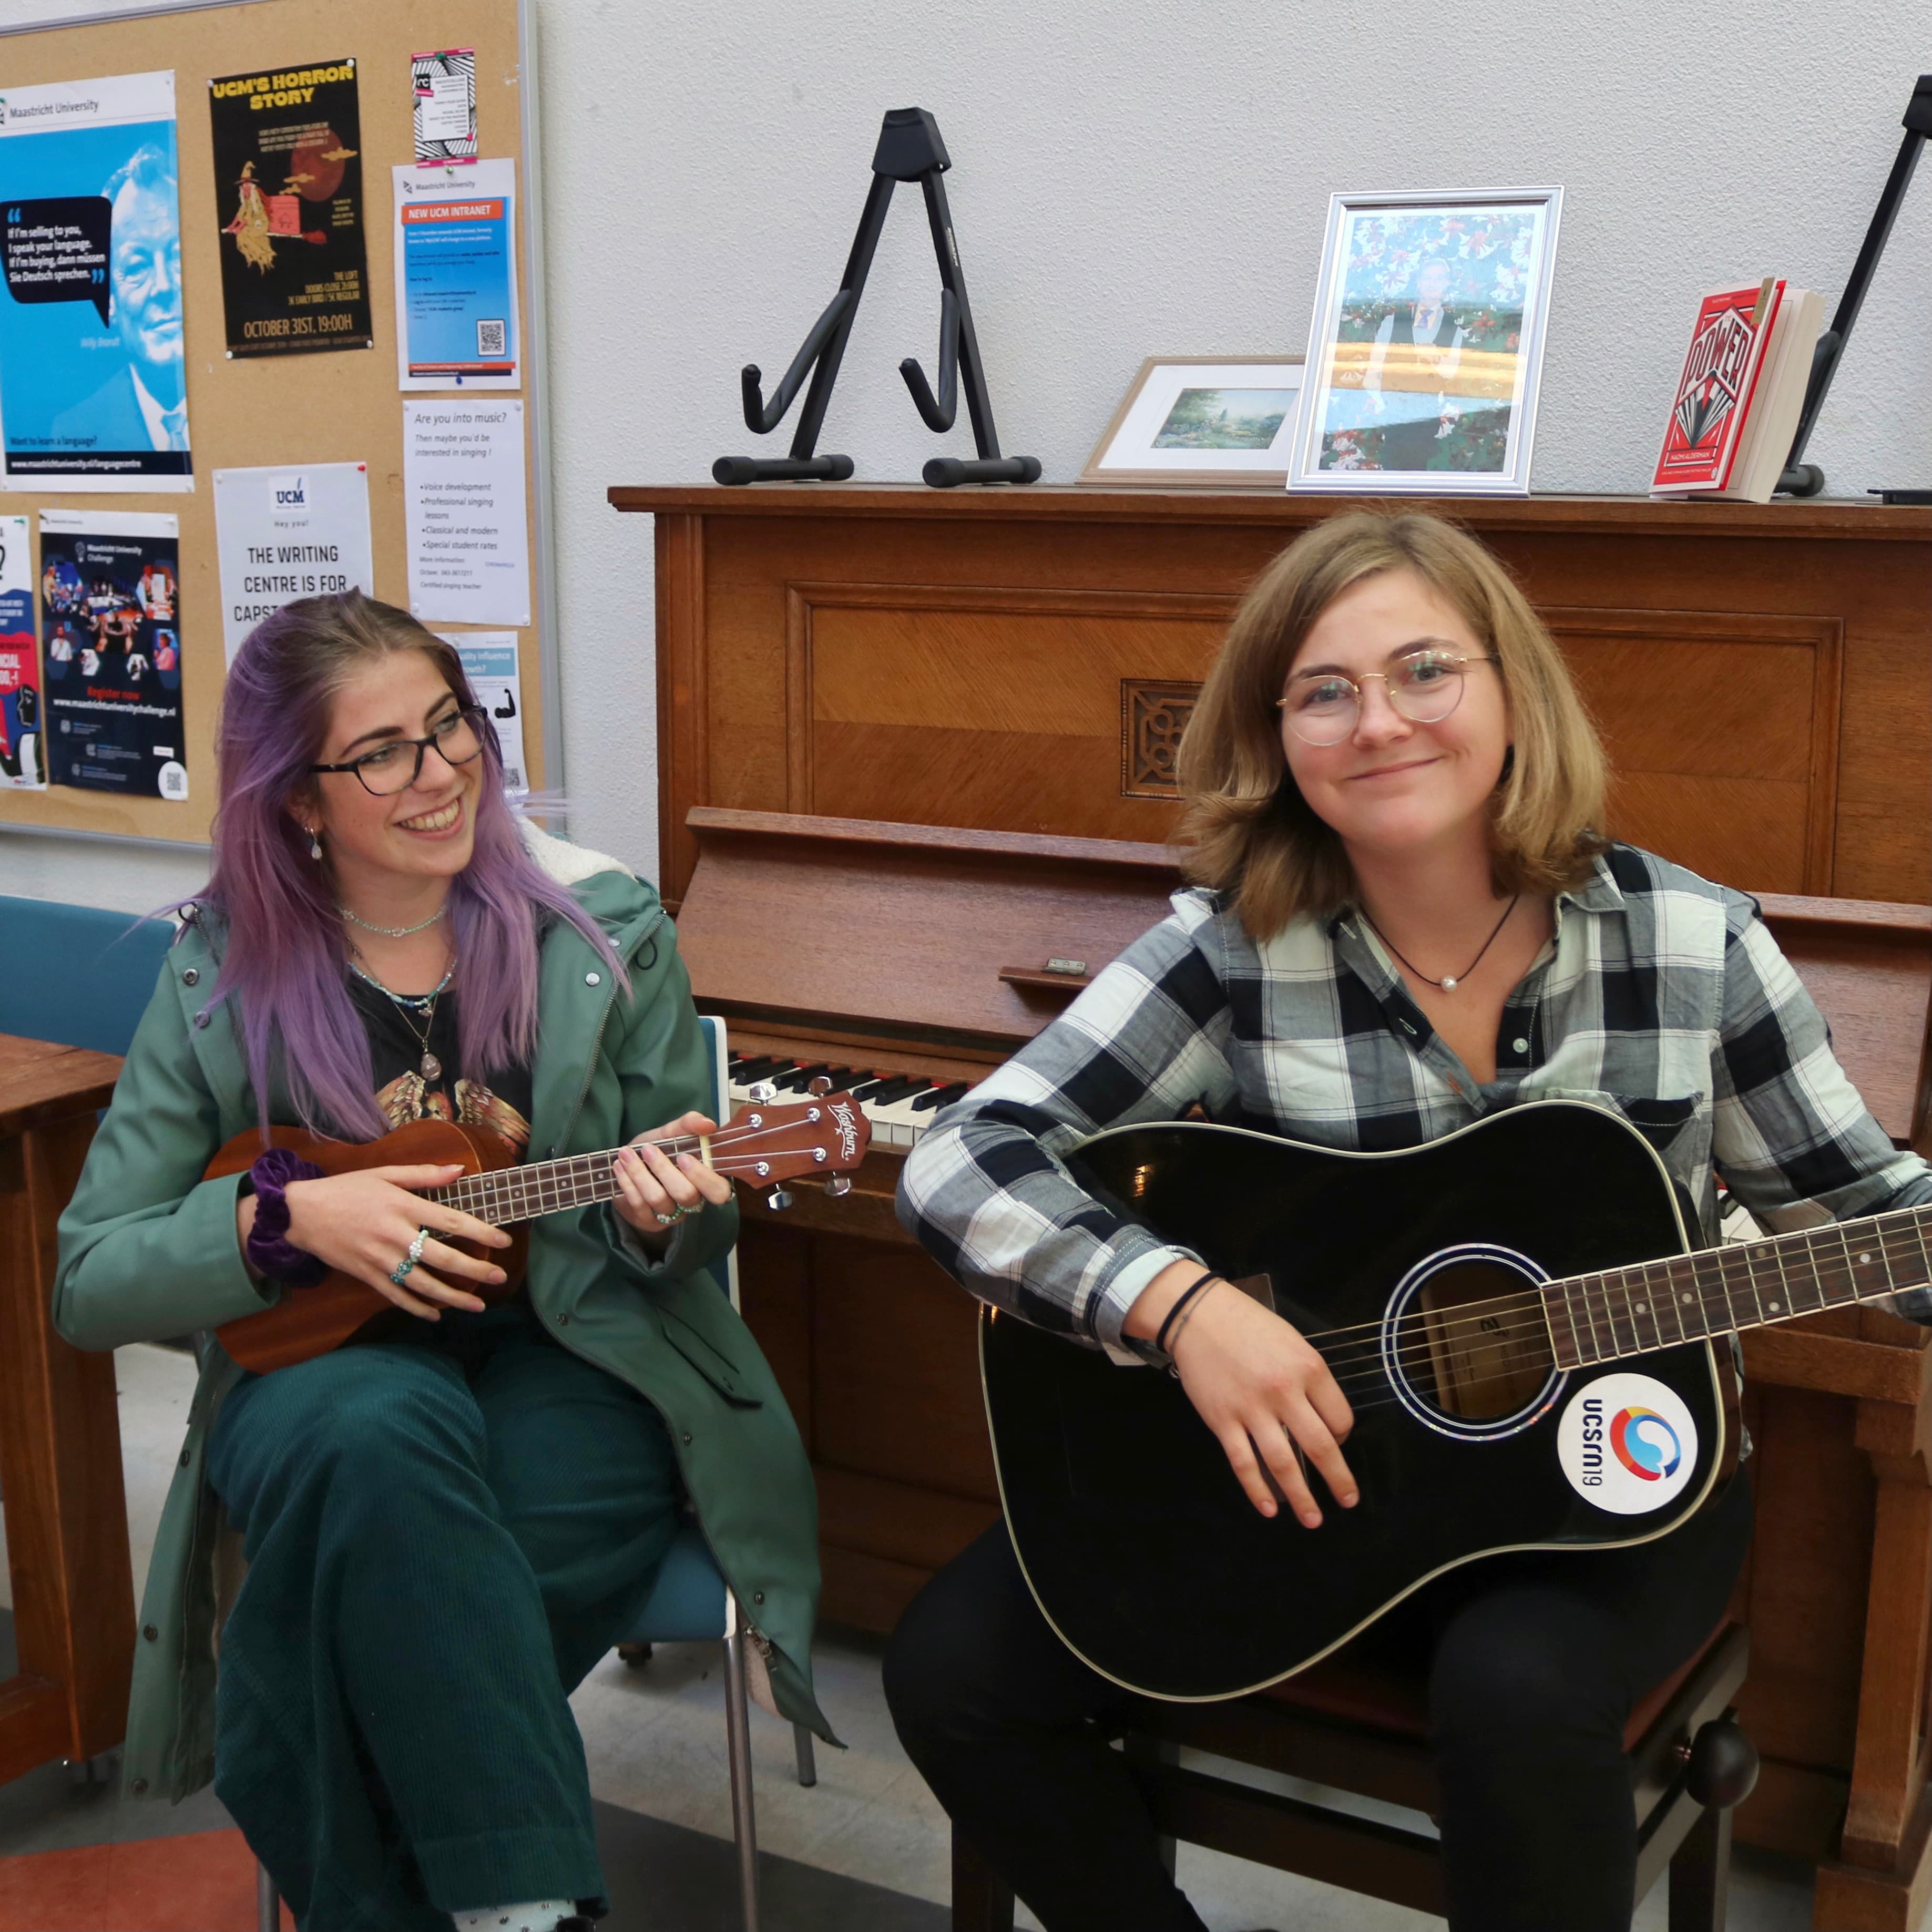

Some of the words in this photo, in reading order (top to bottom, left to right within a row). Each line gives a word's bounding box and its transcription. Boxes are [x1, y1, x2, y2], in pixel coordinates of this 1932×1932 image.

[213, 77, 270, 98] UCM'S
[272, 65, 354, 90] HORROR
[250, 87, 315, 110] STORY
[9, 104, 54, 119] Maastricht
[55, 99, 99, 114] University
[415, 182, 446, 190] Maastricht
[408, 209, 427, 219] NEW
[430, 207, 449, 218] UCM
[451, 205, 492, 216] INTRANET
[28, 226, 54, 239] selling
[54, 225, 64, 236] to
[13, 242, 35, 255] speak
[35, 242, 54, 254] your
[9, 272, 22, 283] Sie
[22, 270, 53, 281] Deutsch
[244, 319, 290, 338] OCTOBER
[318, 314, 353, 333] 19:00H
[1686, 318, 1750, 388] POWER
[414, 413, 431, 424] Are
[432, 414, 451, 426] you
[451, 413, 472, 423] into
[474, 412, 507, 423] music?
[415, 434, 432, 443] Then
[434, 434, 457, 444] maybe
[481, 433, 490, 442] be
[415, 448, 450, 457] interested
[461, 449, 487, 458] singing
[445, 483, 491, 492] development
[276, 490, 304, 503] UCM
[468, 497, 494, 508] singing
[470, 527, 498, 535] modern
[452, 541, 478, 550] student
[480, 542, 498, 550] rates
[248, 547, 274, 564] THE
[278, 546, 338, 564] WRITING
[244, 576, 298, 593] CENTRE
[302, 576, 315, 592] IS
[320, 575, 346, 591] FOR
